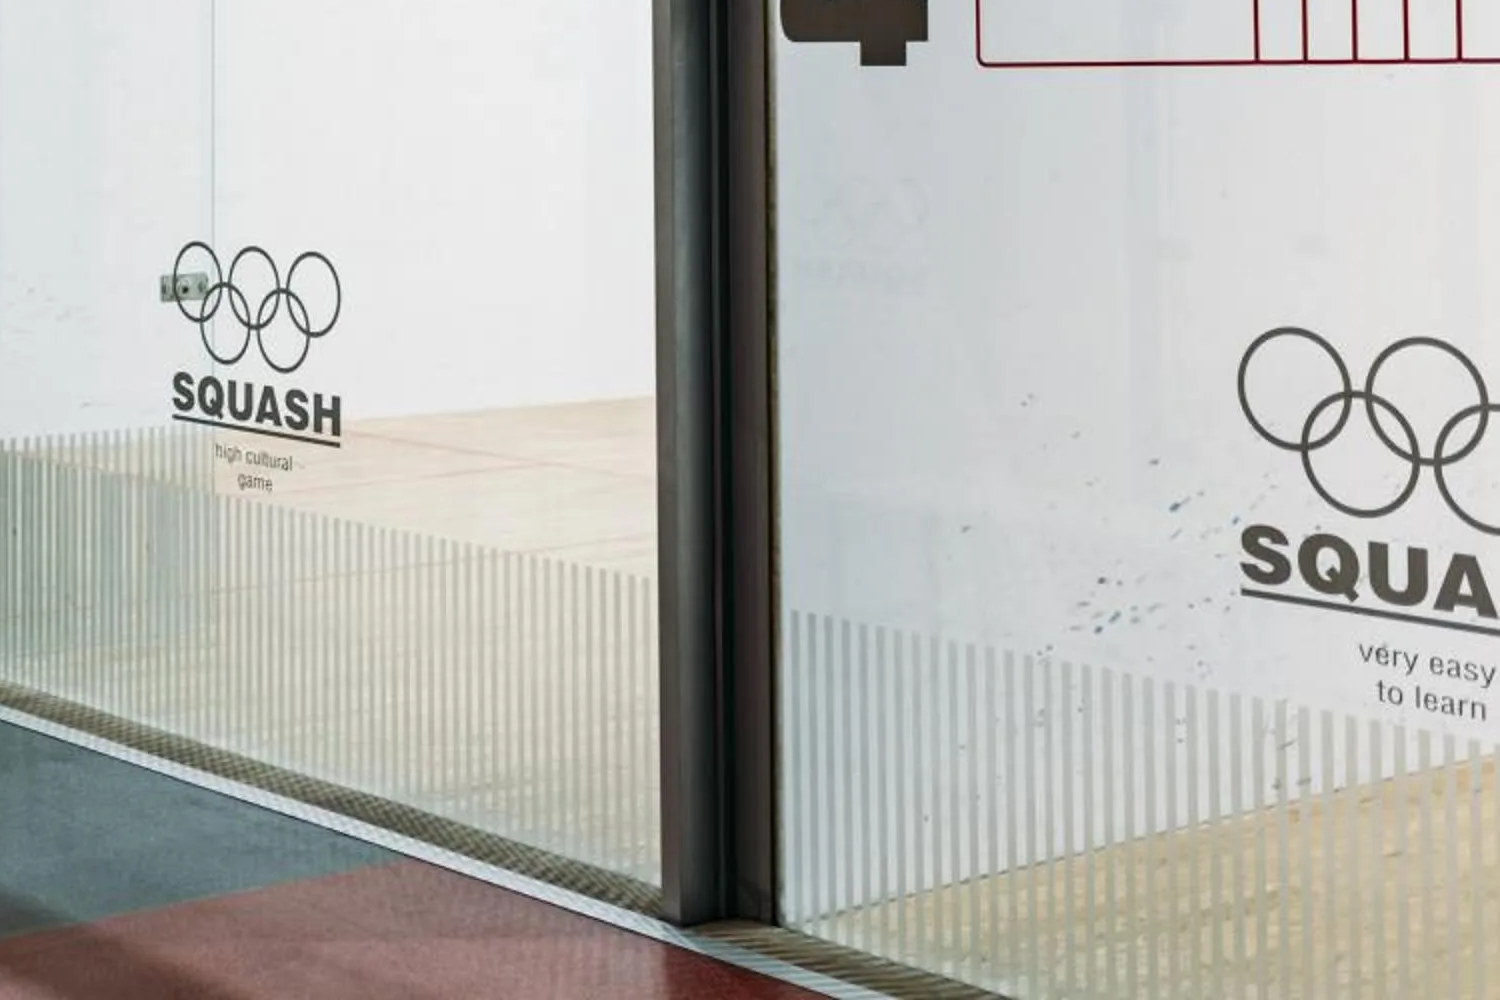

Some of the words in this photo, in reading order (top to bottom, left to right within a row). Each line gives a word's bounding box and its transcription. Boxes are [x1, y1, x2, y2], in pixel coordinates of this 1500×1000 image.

[172, 371, 341, 437] SQUASH
[215, 443, 242, 464] high
[245, 450, 293, 471] cultural
[238, 473, 273, 491] game
[1359, 643, 1419, 676] very
[1429, 655, 1497, 689] easy
[1376, 680, 1404, 706] to
[1415, 686, 1487, 722] learn
